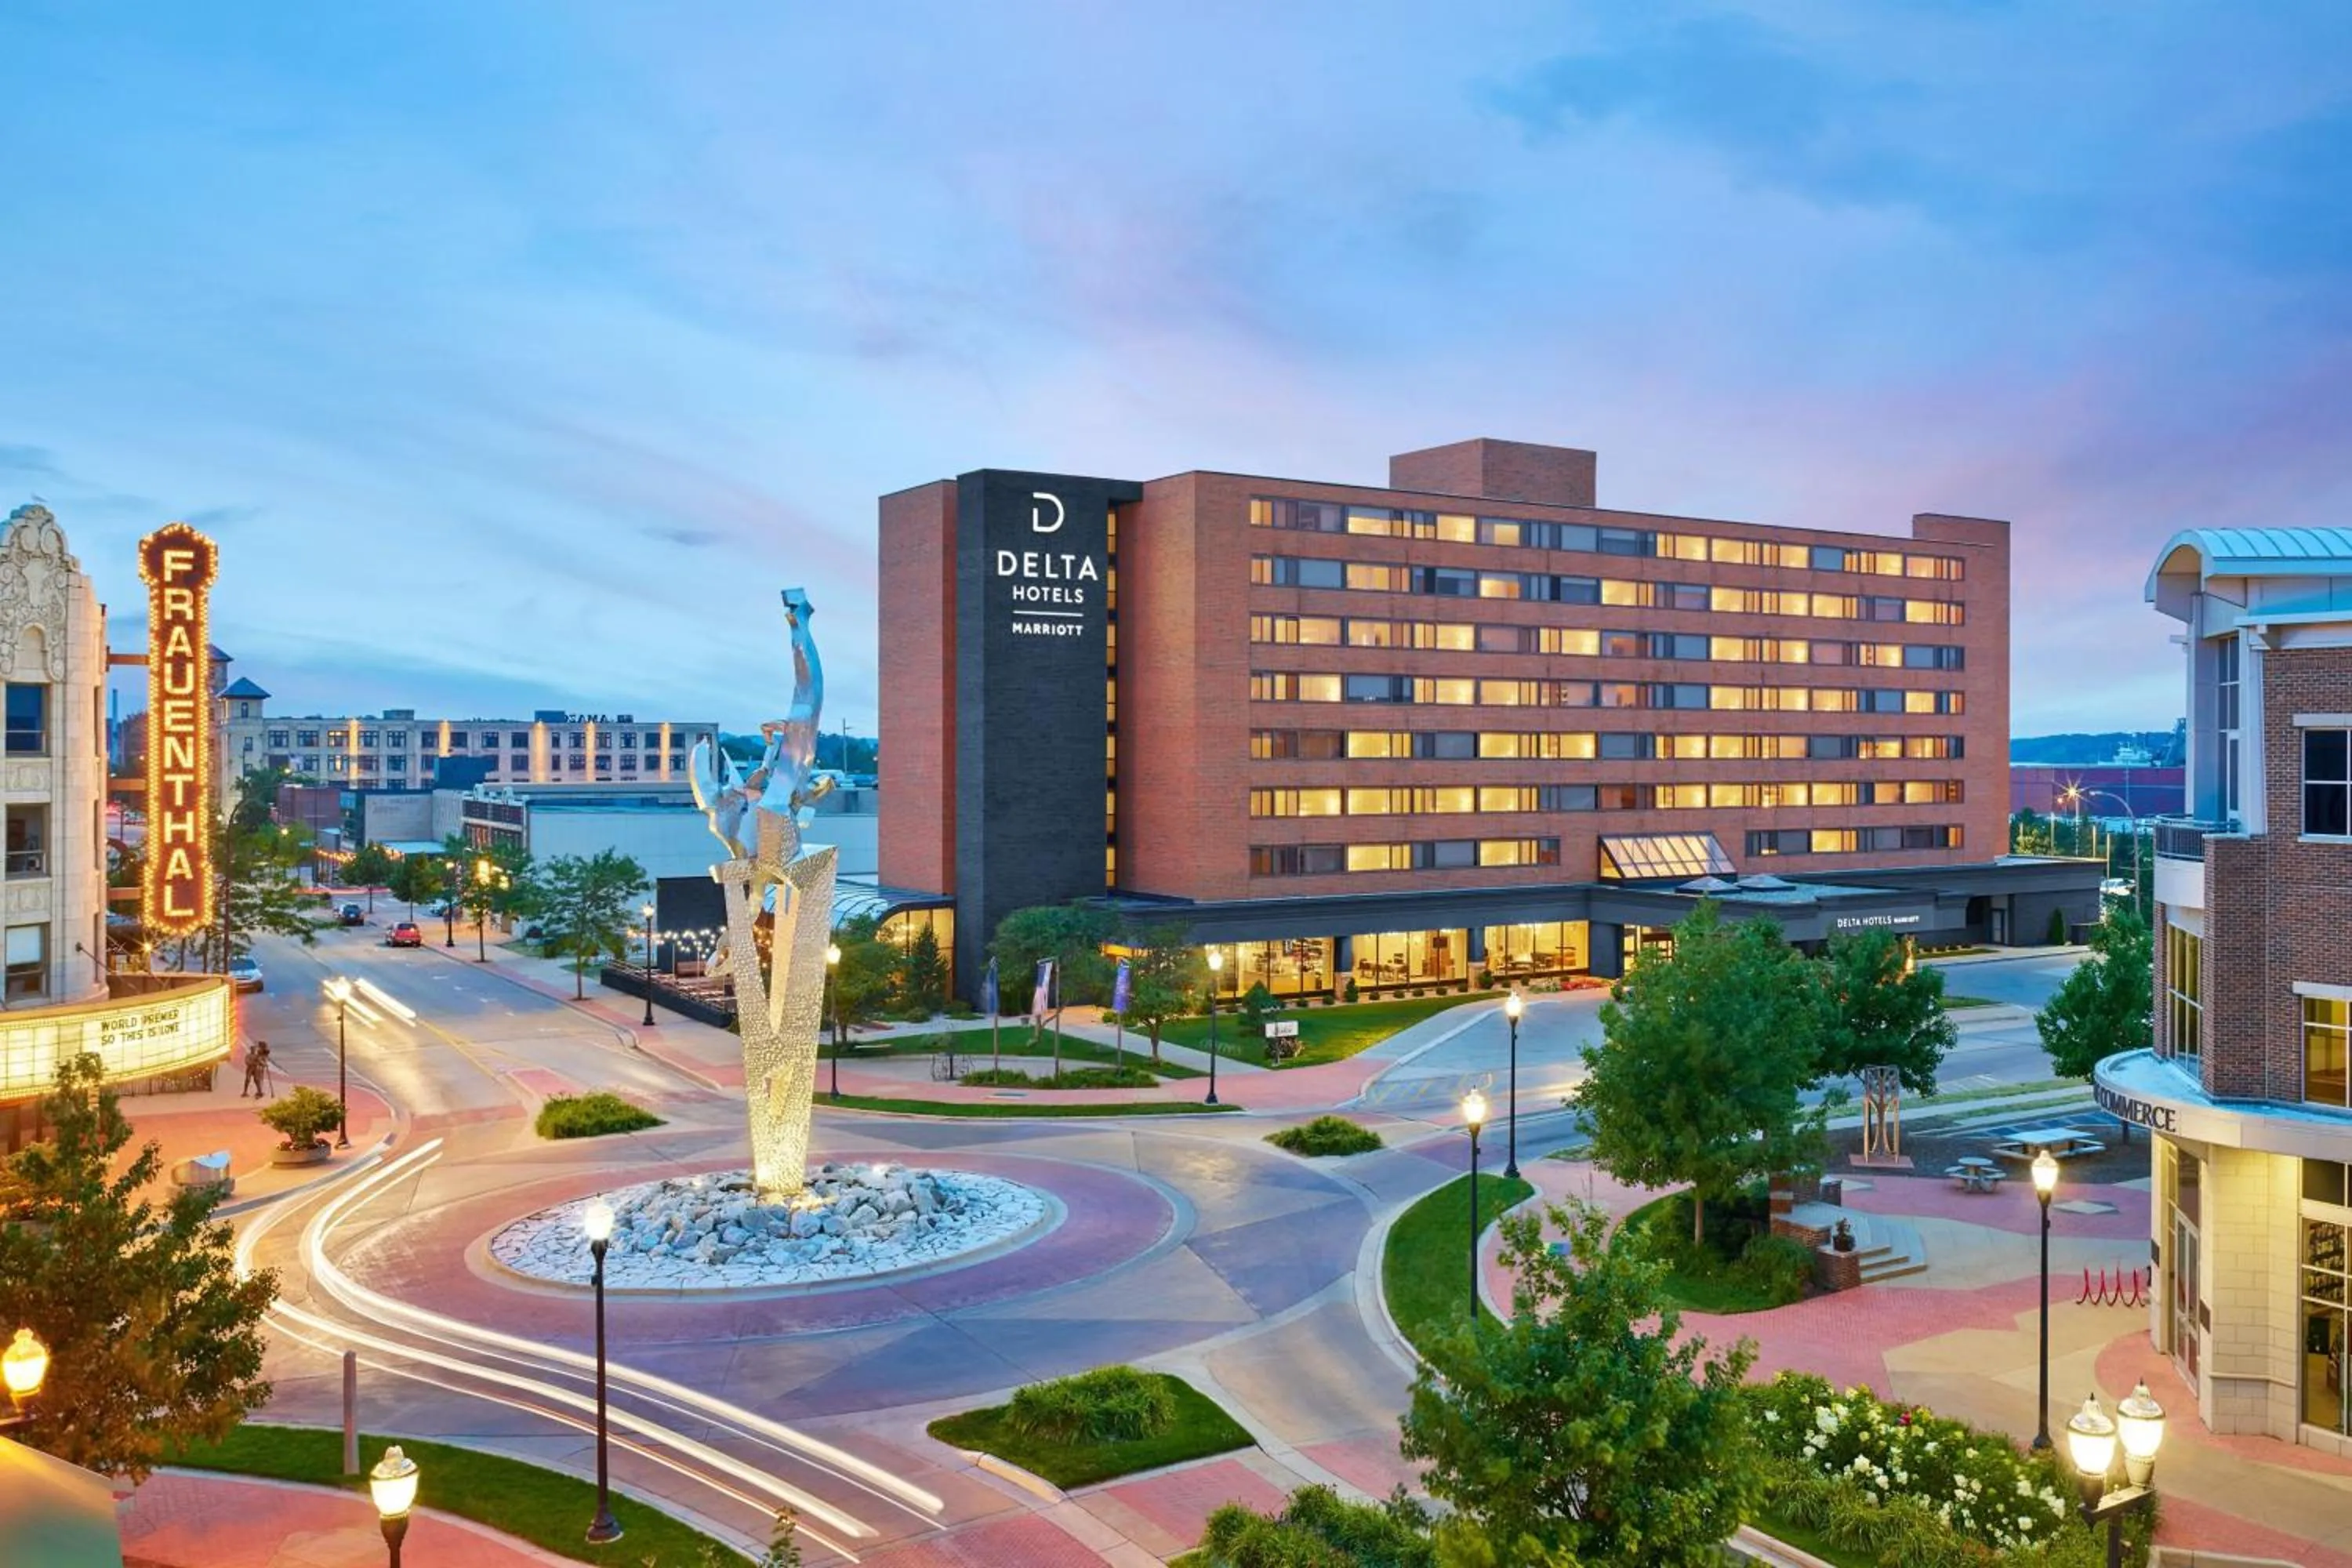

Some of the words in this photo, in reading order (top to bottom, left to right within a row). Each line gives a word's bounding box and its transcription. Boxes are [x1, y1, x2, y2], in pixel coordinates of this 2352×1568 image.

[1033, 492, 1064, 532] D
[997, 550, 1098, 581] DELTA
[1012, 585, 1084, 603] HOTELS
[1012, 622, 1084, 636] MARRIOTT
[163, 550, 194, 916] FRAUENTHAL
[1837, 918, 1860, 927] DELTA
[1863, 916, 1892, 926] HOTELS
[101, 1018, 136, 1032] WORLD
[101, 1034, 114, 1046] SO
[119, 1029, 143, 1043] THIS
[148, 1026, 156, 1037] IS
[161, 1022, 180, 1035] LOVE
[2101, 1087, 2176, 1132] COMMERCE
